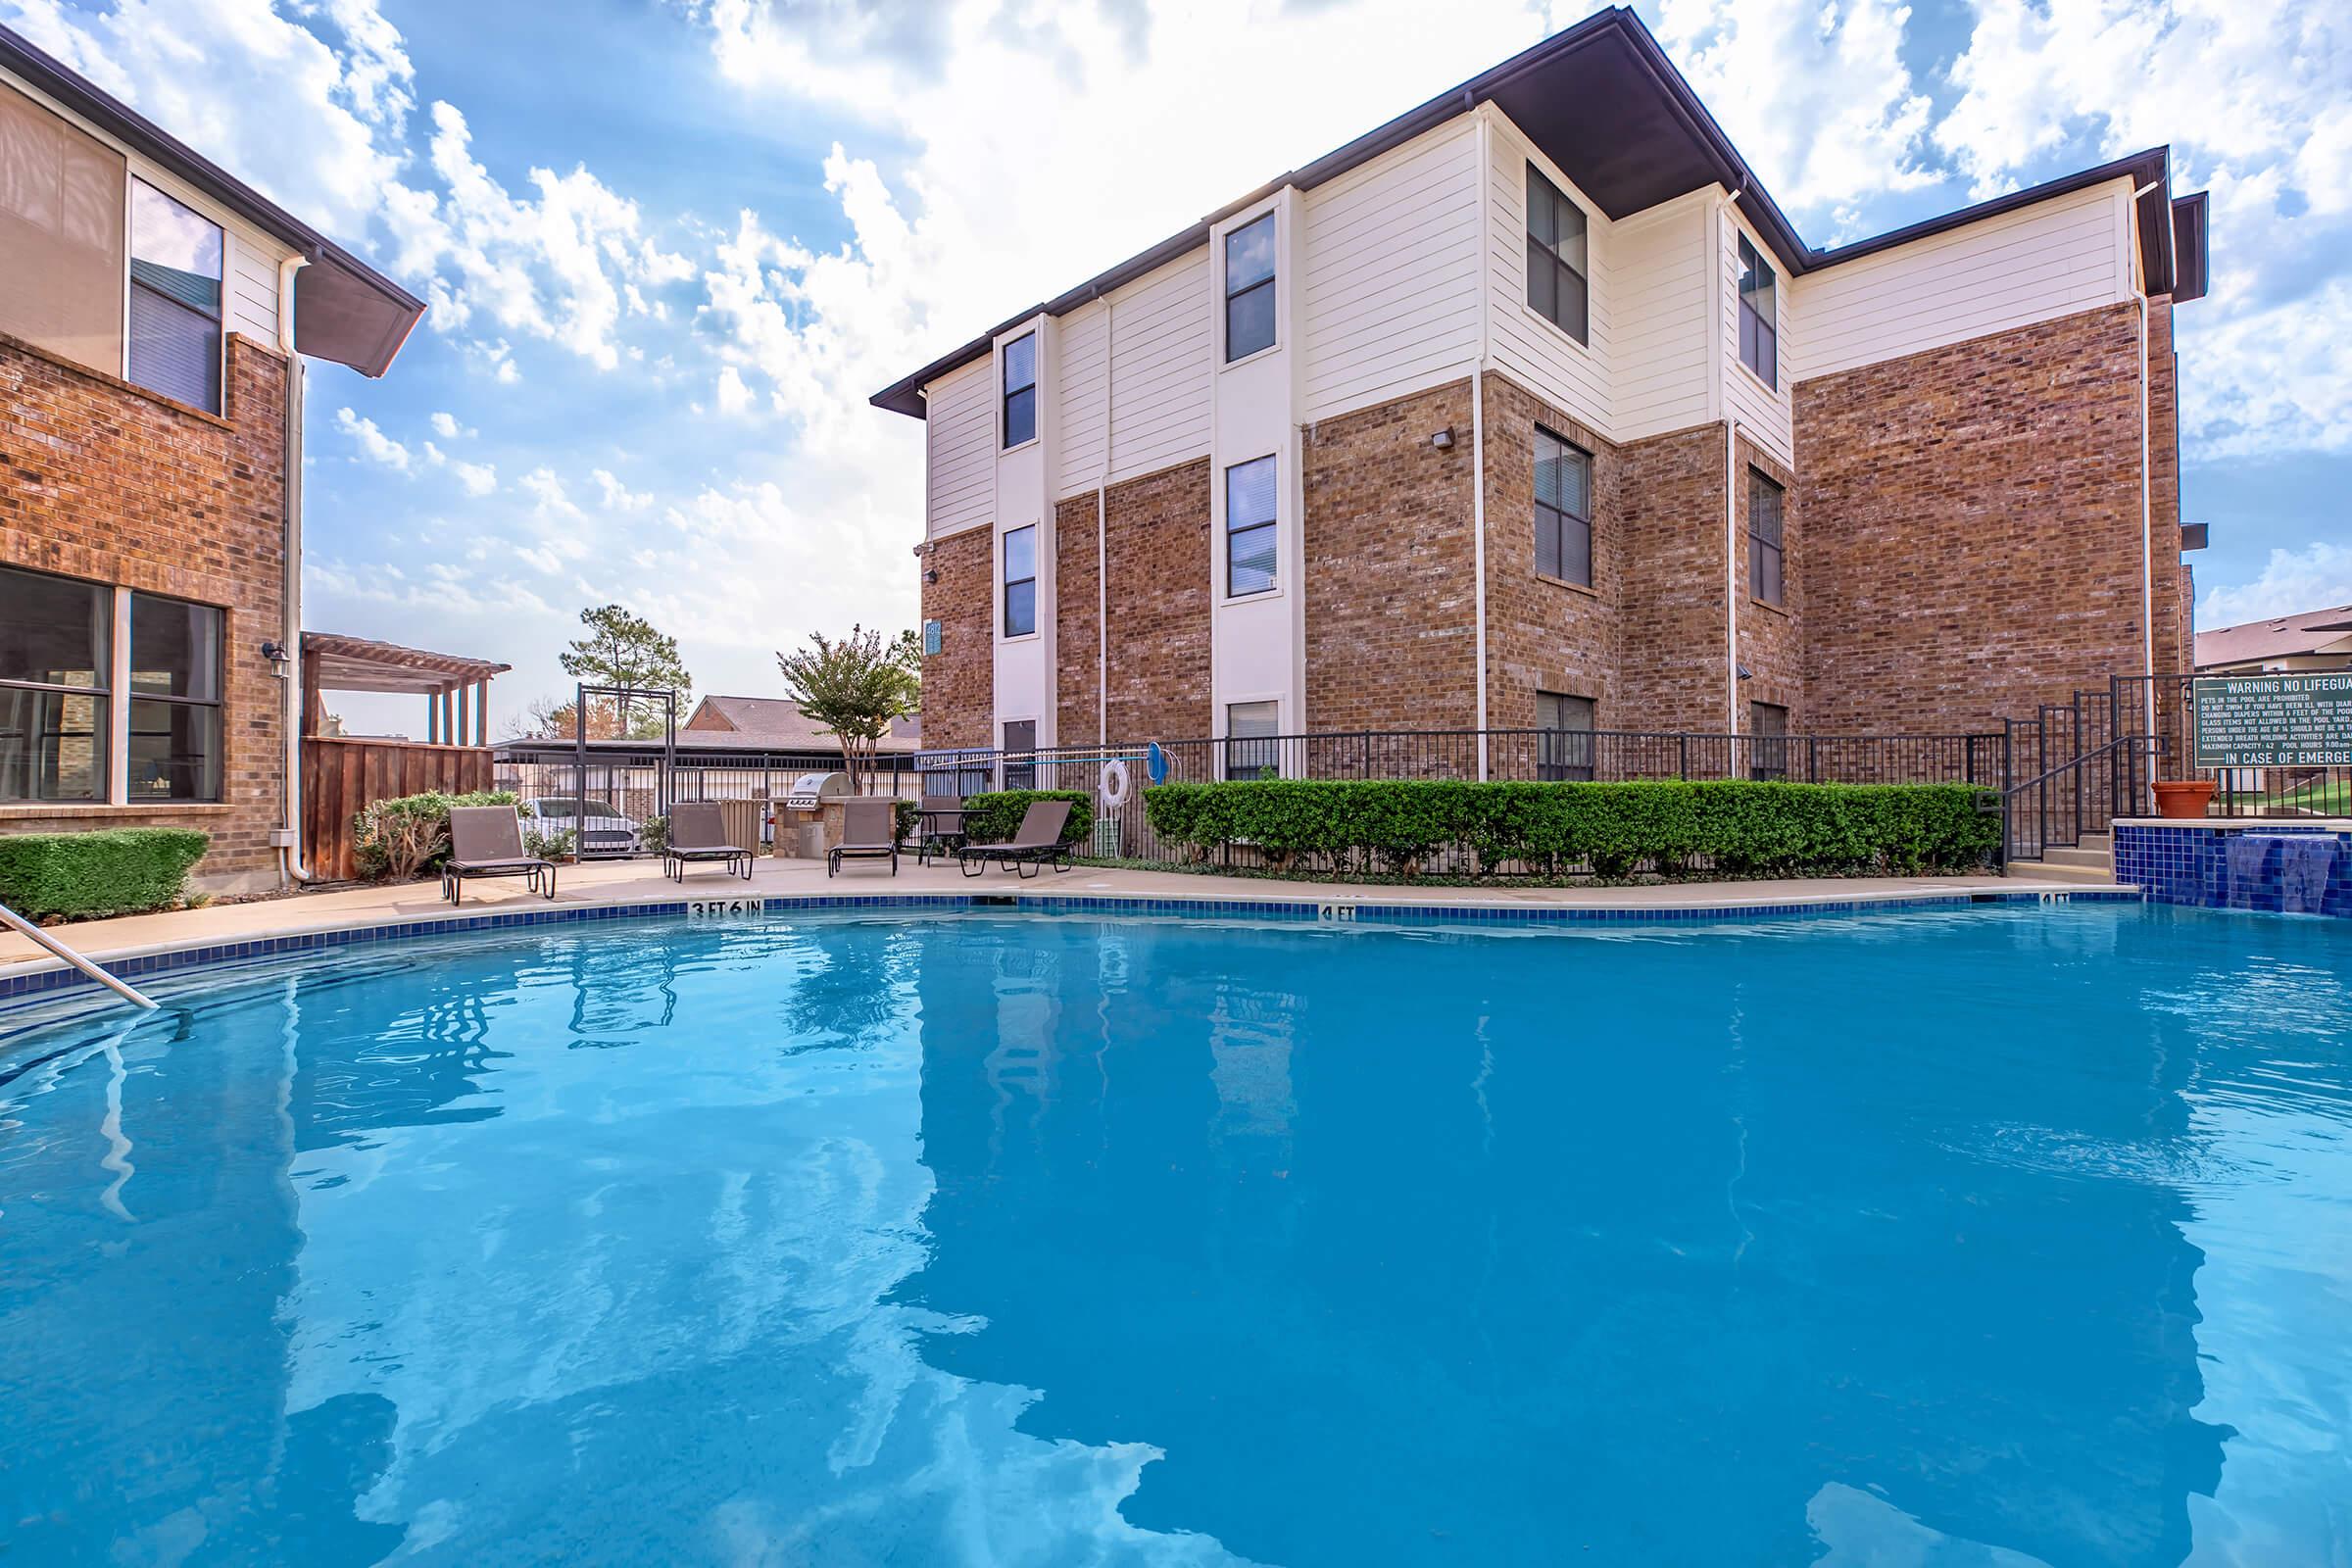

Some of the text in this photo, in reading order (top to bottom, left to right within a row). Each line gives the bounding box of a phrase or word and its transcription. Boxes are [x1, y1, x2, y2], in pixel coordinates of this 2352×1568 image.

[2227, 678, 2352, 693] WARNING NO LIFEGUA
[2226, 751, 2350, 764] IN CASE OF EMERGE
[692, 900, 760, 917] 3 FT 6 IN
[1322, 906, 1354, 921] 4 FT
